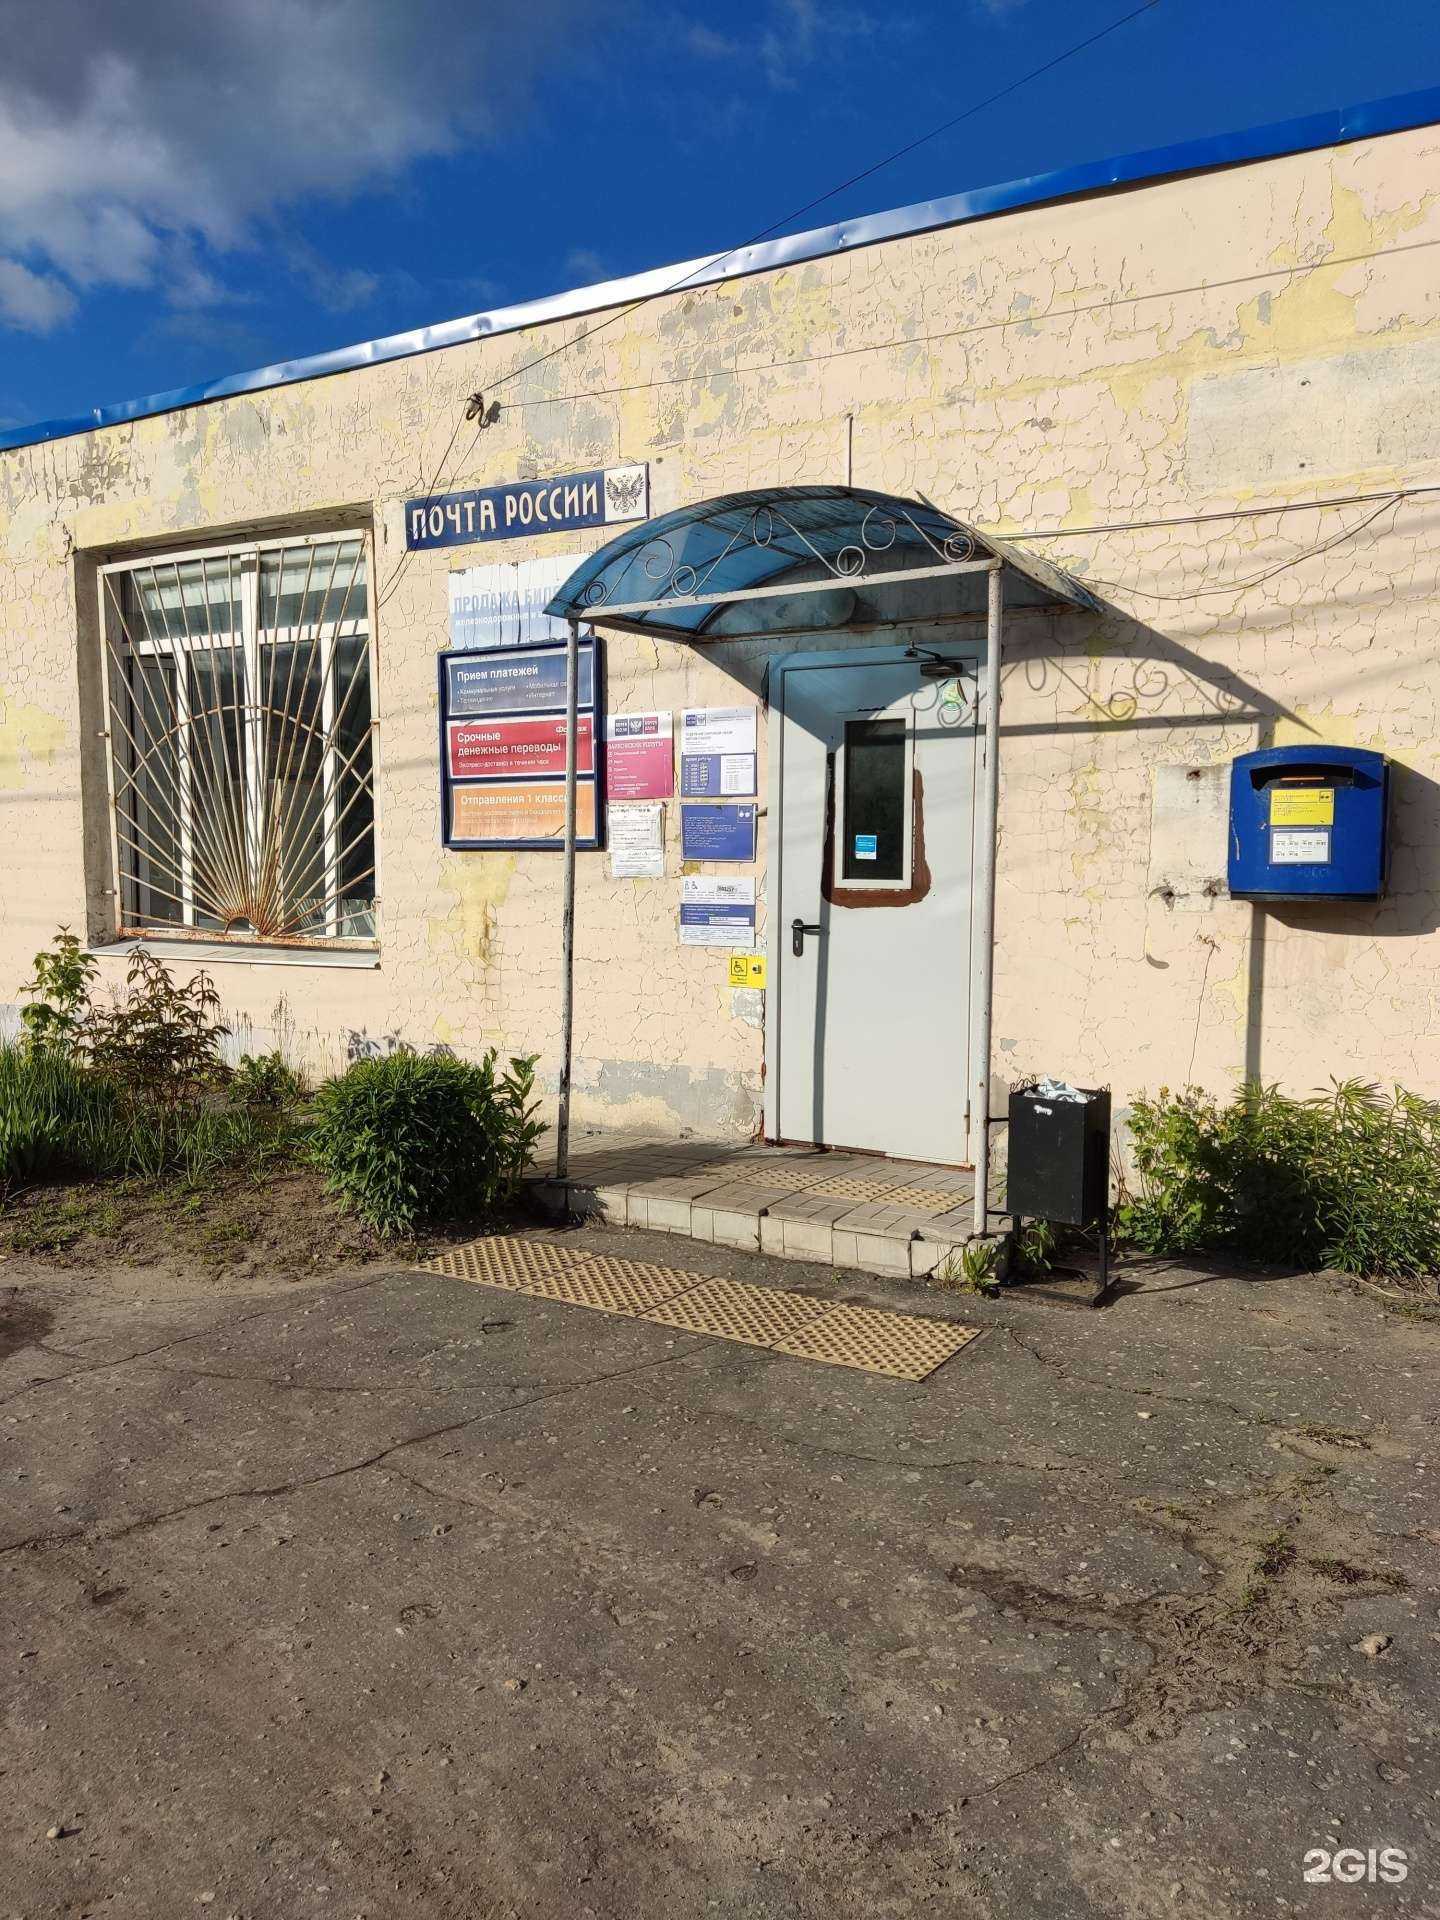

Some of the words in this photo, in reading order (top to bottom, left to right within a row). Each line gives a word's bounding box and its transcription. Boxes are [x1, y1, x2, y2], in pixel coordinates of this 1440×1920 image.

[412, 499, 497, 540] ПОЧТА
[506, 481, 599, 527] РОССИИ
[454, 590, 519, 613] ПРОДАЖА
[457, 670, 488, 684] Прием
[490, 664, 539, 680] платежей
[457, 731, 501, 744] Срочные
[457, 744, 508, 757] денежные
[511, 742, 561, 755] переводы
[461, 794, 525, 806] Отправления
